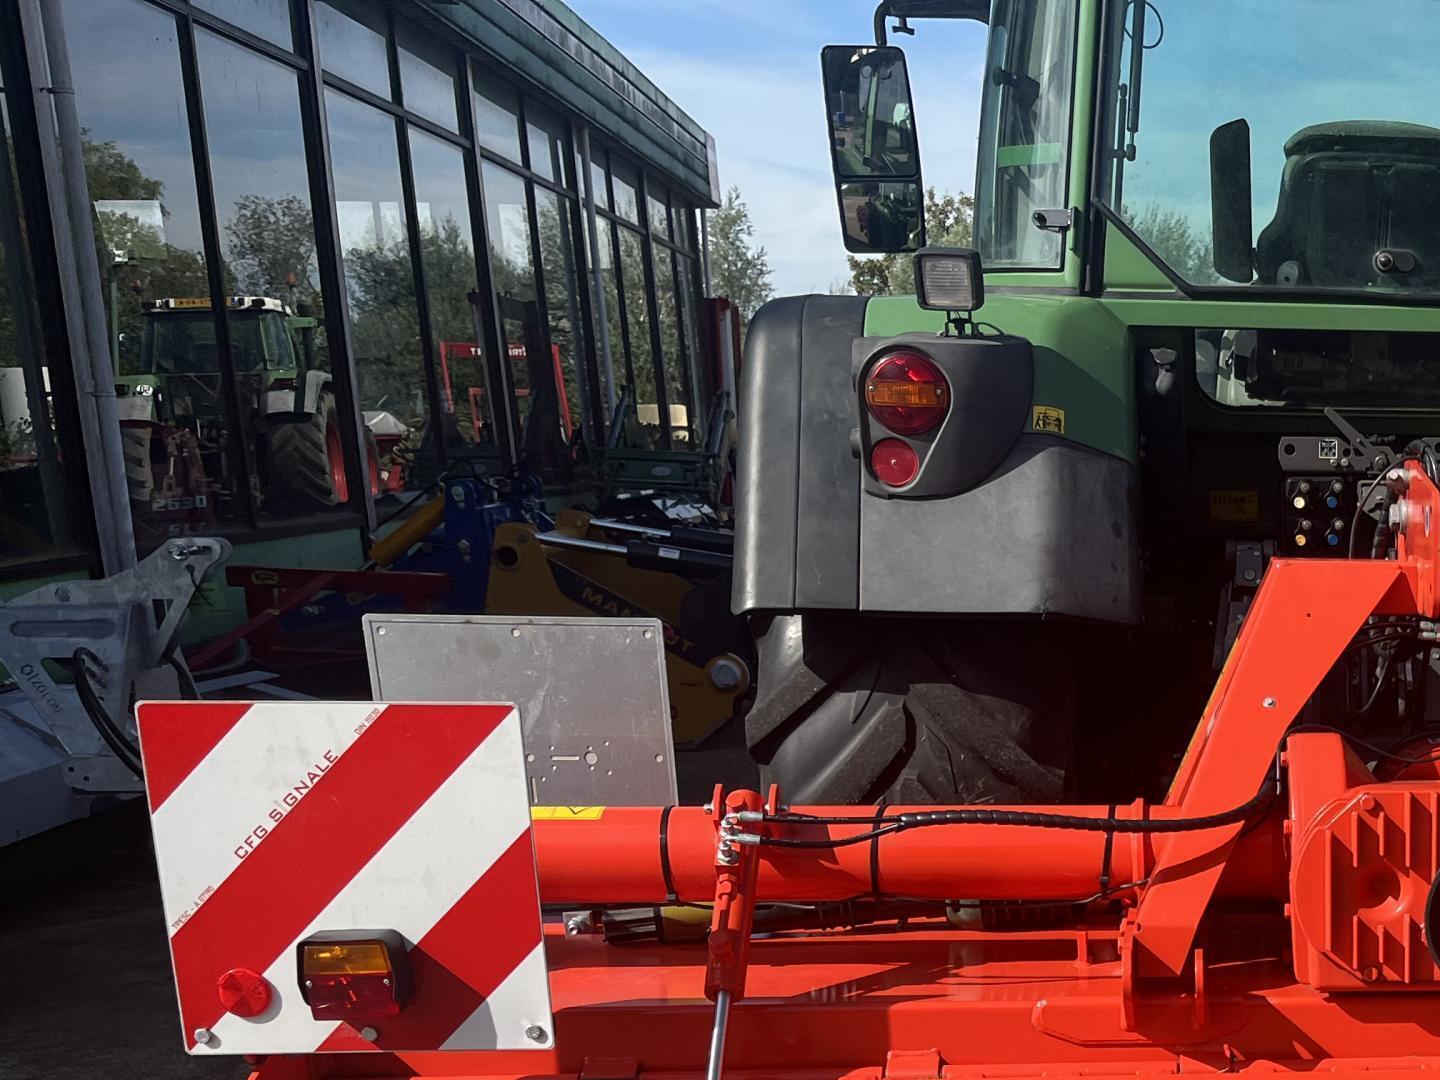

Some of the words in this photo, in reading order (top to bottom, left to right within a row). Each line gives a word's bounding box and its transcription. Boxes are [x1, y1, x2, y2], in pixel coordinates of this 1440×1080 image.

[353, 722, 367, 736] DIN
[234, 825, 268, 860] CFG
[268, 749, 339, 823] SIGNALE
